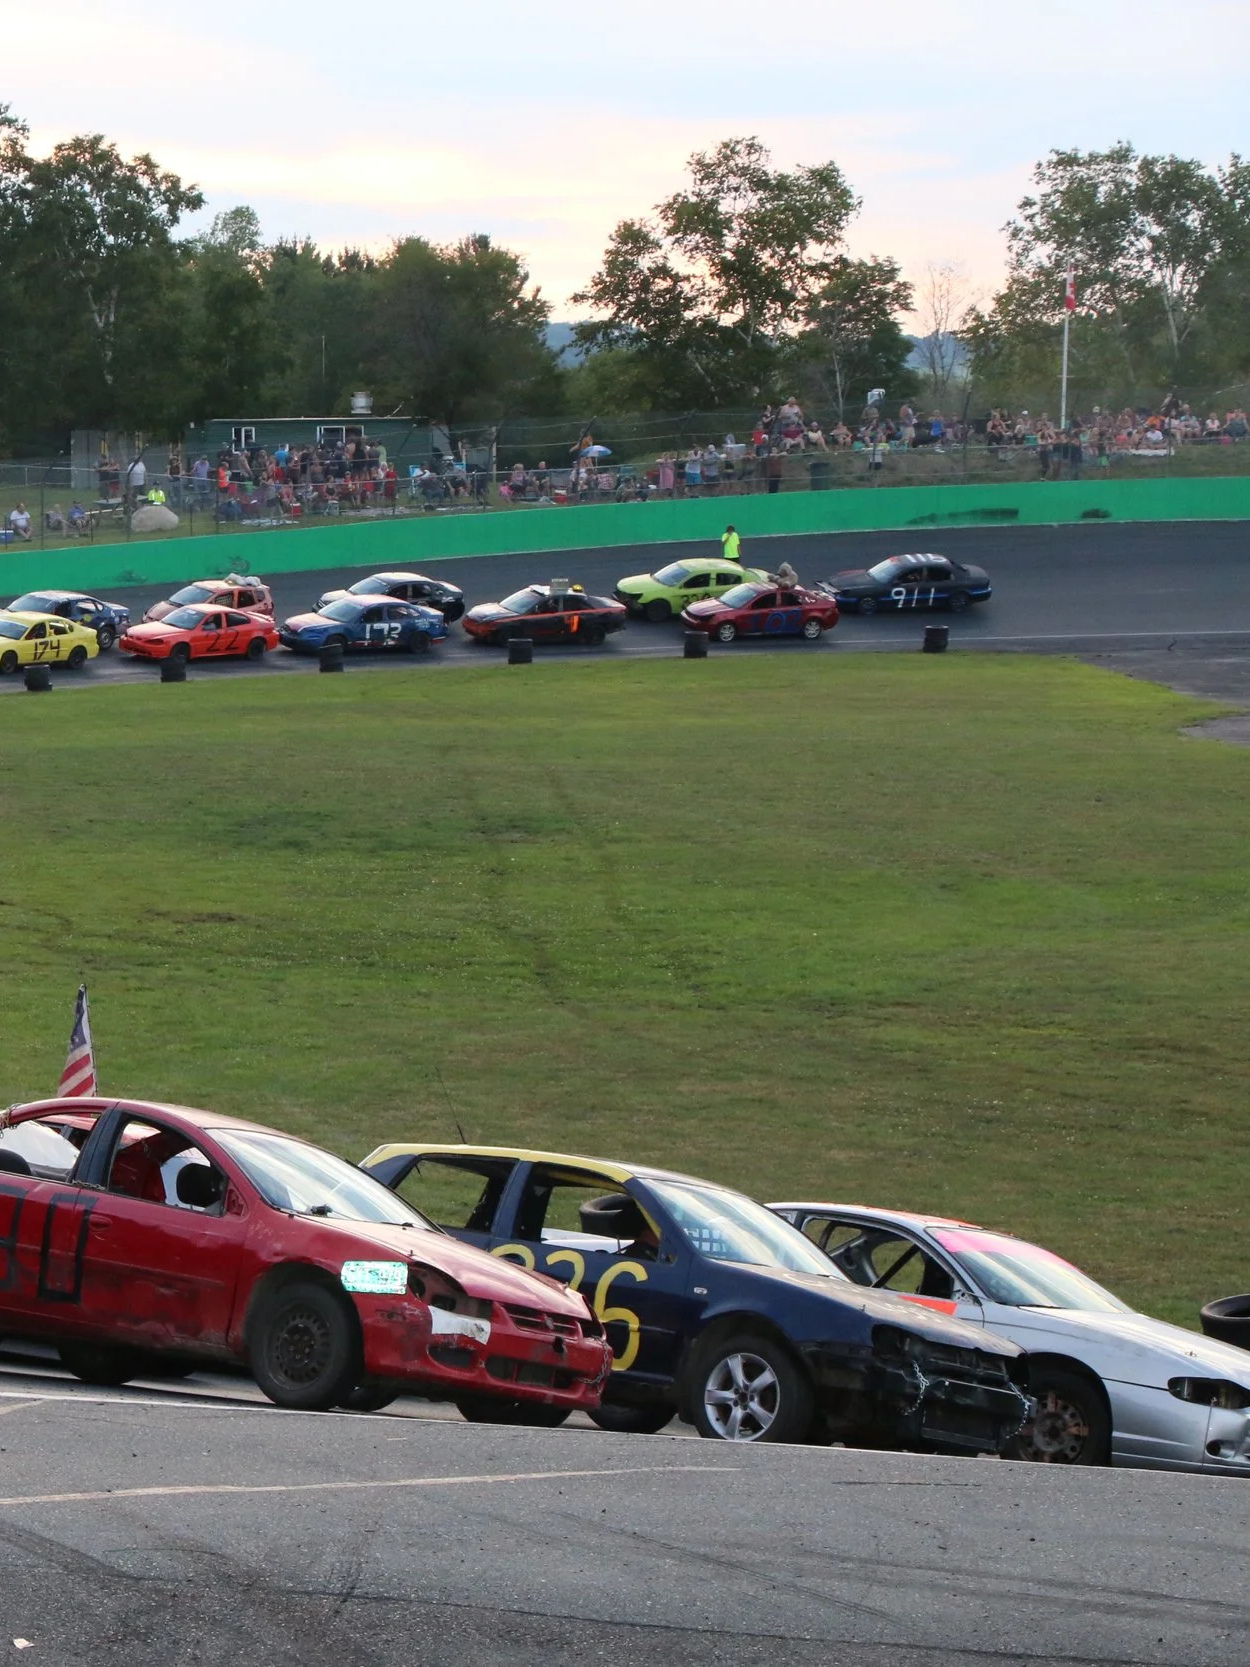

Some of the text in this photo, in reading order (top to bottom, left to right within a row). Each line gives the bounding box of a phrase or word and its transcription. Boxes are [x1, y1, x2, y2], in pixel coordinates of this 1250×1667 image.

[891, 587, 936, 608] 911
[33, 639, 60, 661] 174
[205, 628, 240, 652] 22
